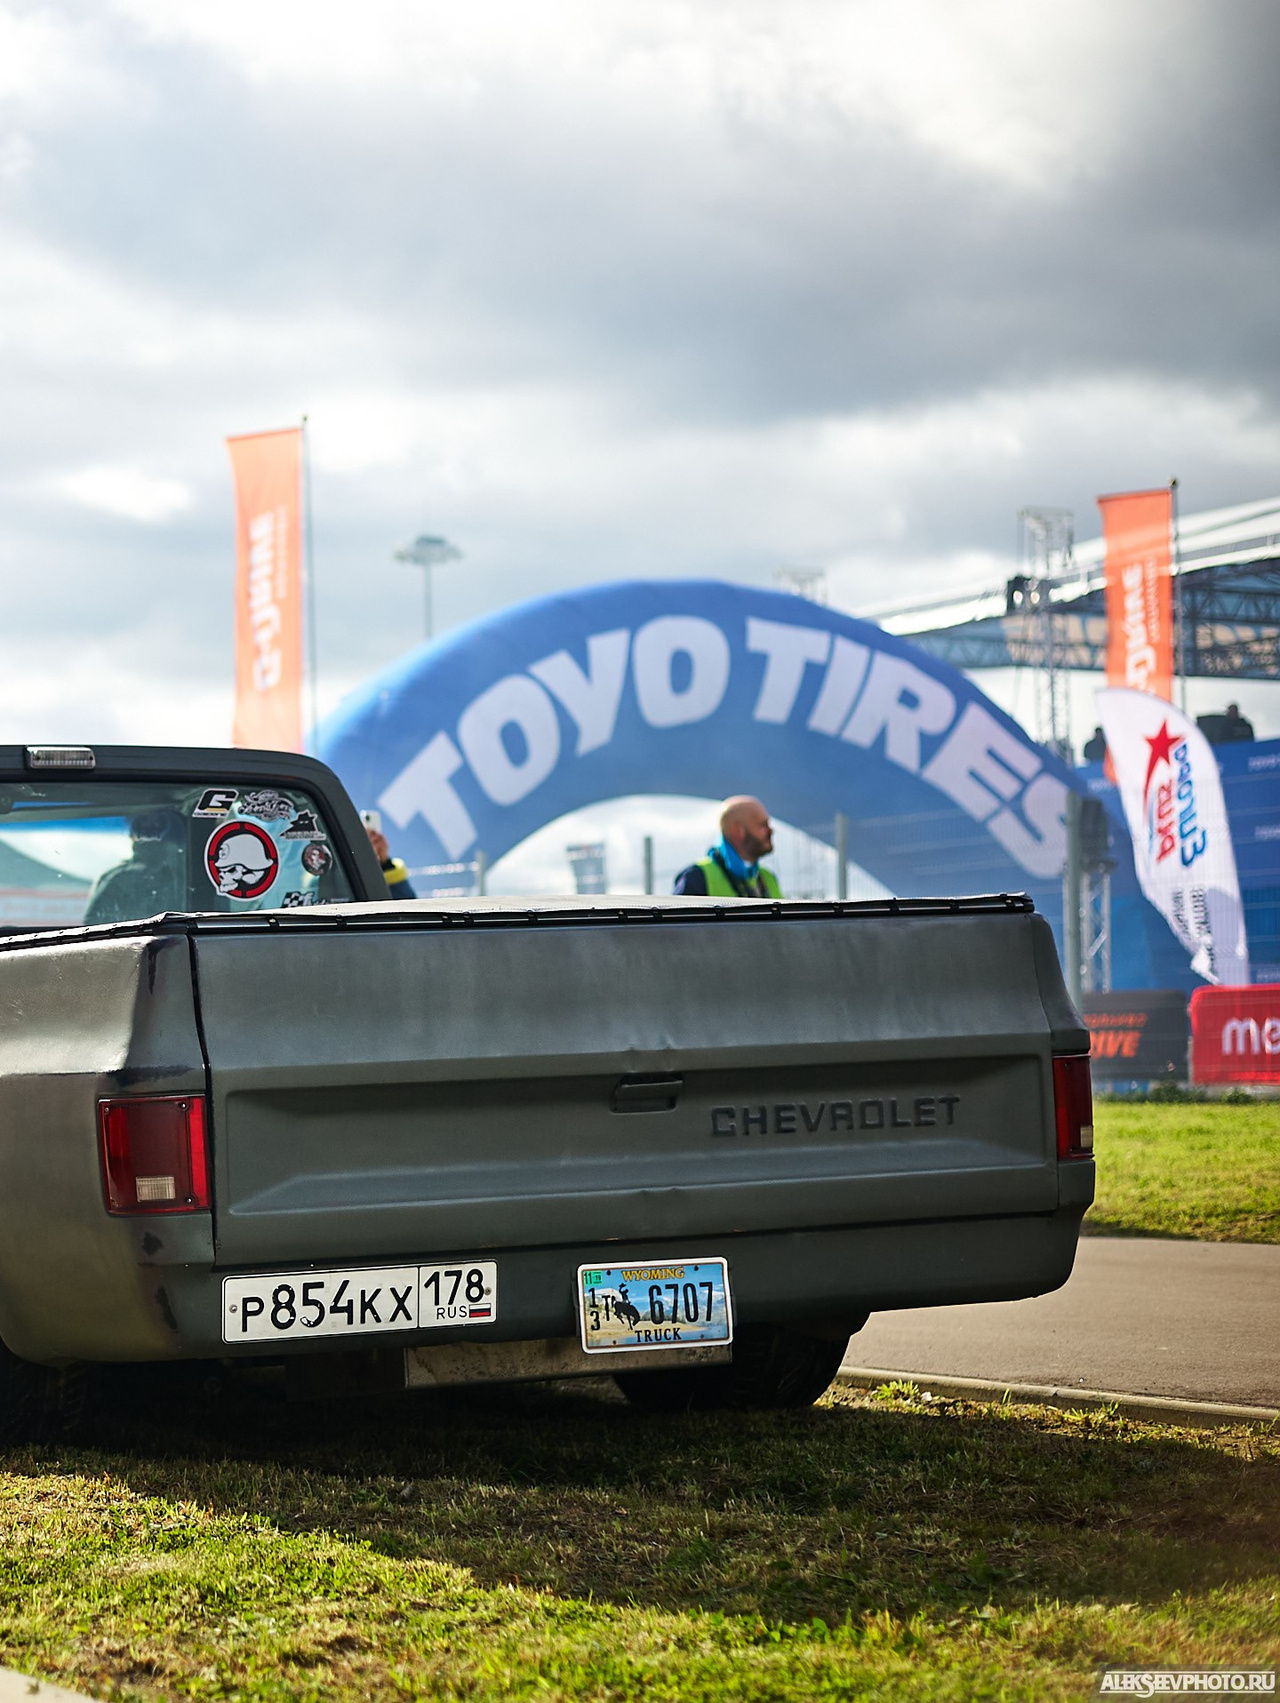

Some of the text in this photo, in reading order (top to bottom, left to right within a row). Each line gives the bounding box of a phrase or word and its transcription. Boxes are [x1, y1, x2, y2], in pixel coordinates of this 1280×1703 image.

[376, 614, 1070, 880] TOYO TIRES
[711, 1094, 961, 1137] CHEVROLET
[424, 1268, 485, 1307] 178
[621, 1267, 685, 1281] WYOMING
[436, 1305, 468, 1320] RUS
[648, 1281, 713, 1325] 6707
[635, 1328, 682, 1343] TRUCK
